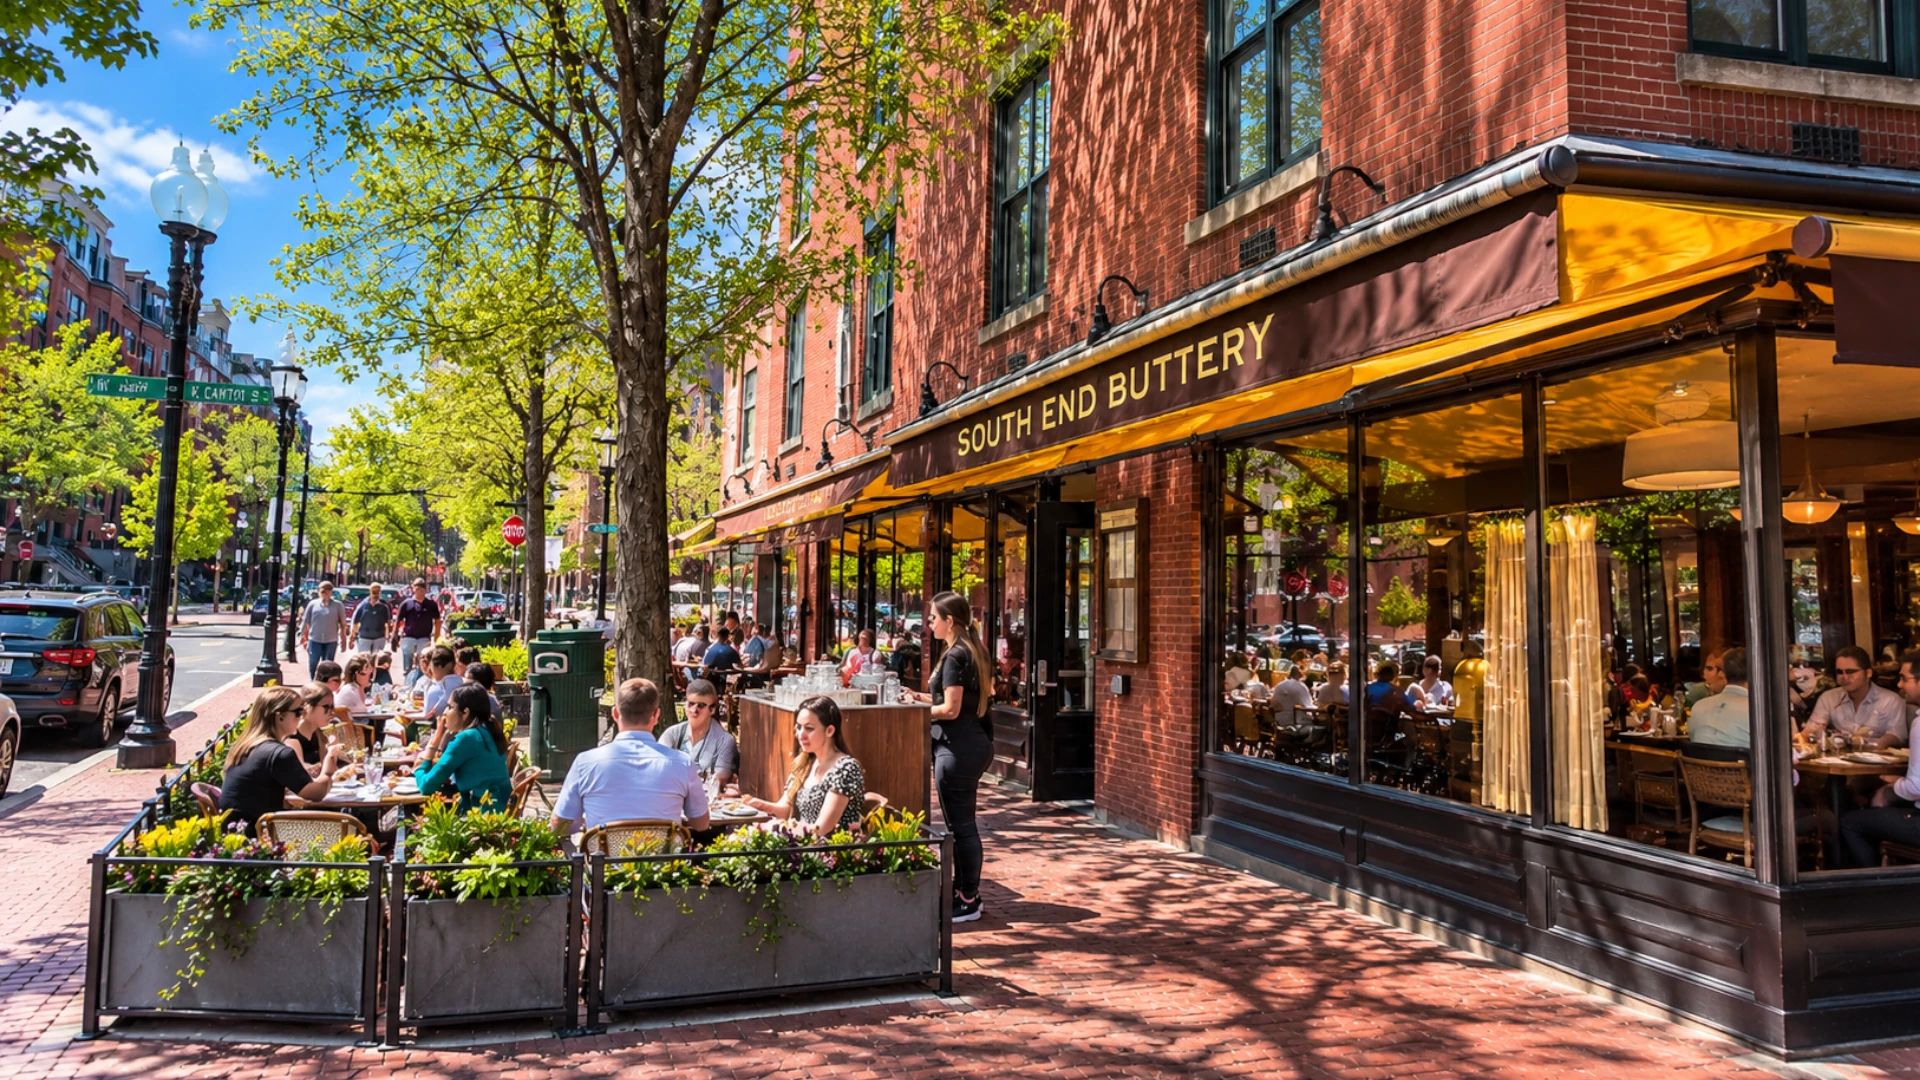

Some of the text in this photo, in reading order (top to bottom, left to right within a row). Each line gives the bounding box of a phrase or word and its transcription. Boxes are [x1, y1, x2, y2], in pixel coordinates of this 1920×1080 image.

[957, 312, 1276, 457] SOUTH END BUTTERY
